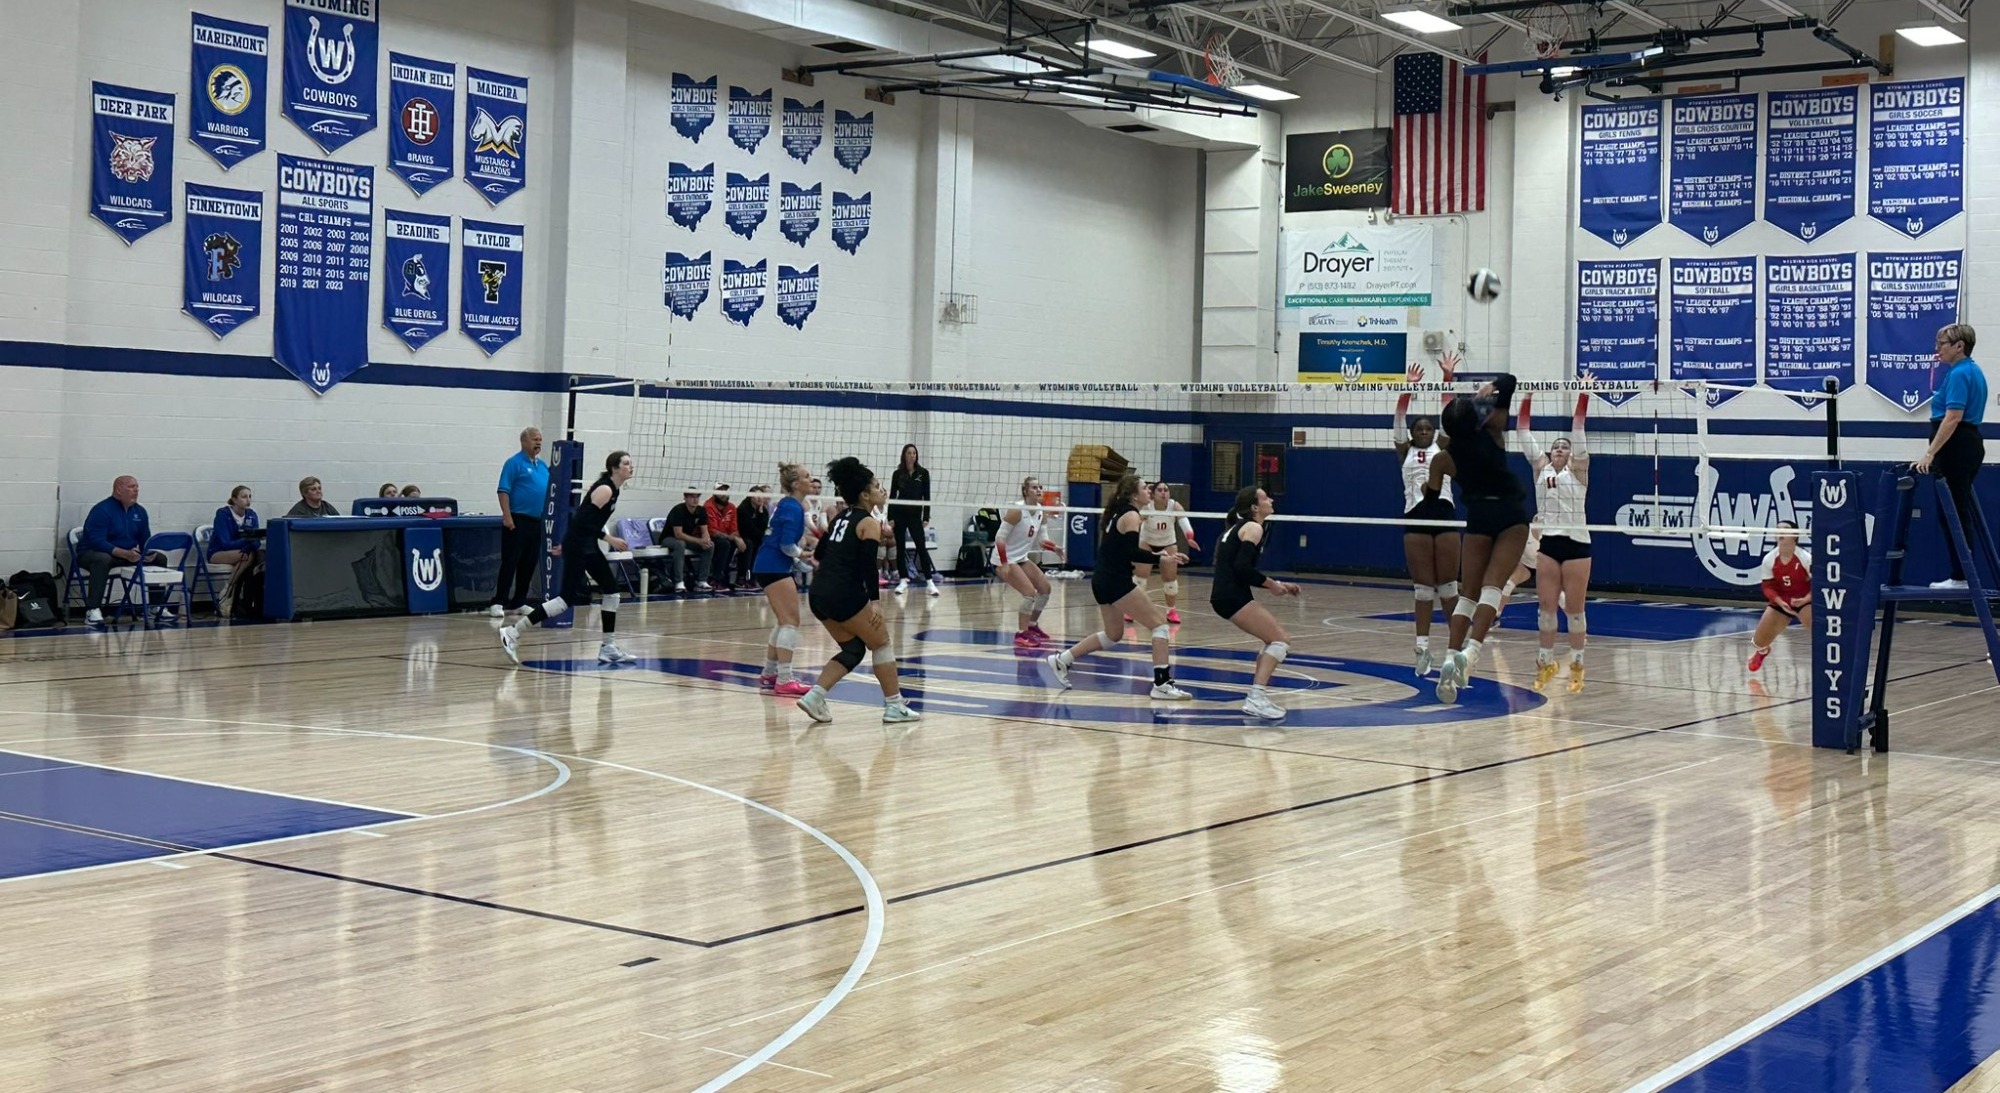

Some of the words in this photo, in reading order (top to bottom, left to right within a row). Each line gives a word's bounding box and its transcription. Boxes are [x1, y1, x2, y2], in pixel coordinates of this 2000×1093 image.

[296, 0, 369, 16] OMING
[196, 28, 264, 52] MARIEMONT
[318, 37, 344, 70] W
[393, 66, 425, 83] INDIAN
[430, 74, 452, 87] HILL
[303, 87, 357, 107] COWBOYS
[477, 82, 517, 99] MADEIRA
[672, 88, 718, 103] COWBOYS
[1874, 87, 1960, 109] COWBOYS
[100, 98, 131, 115] DEER
[137, 104, 167, 120] PARK
[729, 101, 772, 115] COWBOYS
[1675, 103, 1754, 123] COWBOYS
[1771, 96, 1854, 117] COWBOYS
[783, 112, 824, 127] COWBOYS
[1584, 109, 1658, 129] COWBOYS
[1889, 111, 1911, 119] GIRLS
[1913, 109, 1943, 118] SOCCER
[207, 122, 249, 136] WARRIORS
[1676, 126, 1696, 134] GIRLS
[1697, 125, 1719, 133] CROSS
[1720, 123, 1752, 132] COUNTRY
[1789, 118, 1833, 127] VOLLEYBALL
[1916, 122, 1946, 130] CHAMPS
[834, 123, 873, 138] COWBOYS
[1811, 130, 1839, 138] CHAMPS
[1619, 141, 1645, 149] CHAMPS
[1714, 136, 1740, 144] CHAMPS
[407, 153, 434, 164] BRAVES
[475, 155, 509, 167] MUSTANGS
[479, 165, 510, 176] AMAZONS
[1812, 169, 1841, 178] CHAMPS
[1918, 163, 1948, 172] CHAMPS
[281, 167, 370, 199] COWBOYS
[668, 177, 714, 192] COWBOYS
[1293, 183, 1383, 197] JakeSweeney
[1873, 181, 1883, 189] '21
[726, 186, 769, 201] COWBOYS
[110, 196, 152, 209] WILDCATS
[189, 198, 259, 217] FINNEYTOWN
[302, 196, 316, 206] ALL
[319, 199, 348, 210] SPORTS
[781, 195, 822, 210] COWBOYS
[832, 205, 871, 219] COWBOYS
[299, 213, 315, 222] CHL
[318, 216, 351, 227] CHAMPS
[1910, 222, 1919, 231] W
[280, 224, 298, 234] 2001
[303, 227, 322, 236] 2002
[327, 229, 345, 239] 2003
[350, 232, 369, 241] 2004
[397, 224, 439, 239] READING
[1707, 230, 1715, 239] W
[280, 237, 298, 248] 2005
[303, 240, 322, 250] 2006
[326, 242, 345, 252] 2007
[350, 245, 369, 254] 2008
[476, 234, 510, 247] TAYLOR
[280, 251, 298, 261] 2009
[303, 253, 321, 263] 2010
[326, 256, 344, 265] 2011
[350, 258, 369, 268] 2012
[1304, 252, 1375, 278] Drayer
[280, 265, 298, 274] 2013
[302, 267, 321, 276] 2014
[326, 269, 344, 279] 2015
[349, 271, 368, 281] 2016
[665, 265, 711, 282] COWBOYS
[1582, 268, 1656, 285] COWBOYS
[1674, 266, 1752, 284] COWBOYS
[1769, 263, 1852, 281] COWBOYS
[1871, 260, 1958, 279] COWBOYS
[280, 278, 296, 288] 2019
[302, 280, 318, 288] 2021
[326, 281, 343, 290] 2023
[723, 272, 767, 288] COWBOYS
[777, 277, 819, 294] COWBOYS
[1904, 282, 1946, 290] SWIMMING
[1695, 286, 1730, 294] SOFTBALL
[1775, 284, 1797, 292] GIRLS
[1799, 284, 1844, 292] BASKETBALL
[203, 293, 242, 304] WILDCATS
[1810, 296, 1838, 304] CHAMPS
[1913, 295, 1943, 303] CHAMPS
[395, 308, 412, 318] BLUE
[414, 310, 437, 319] DEVILS
[464, 313, 490, 323] YELLOW
[491, 315, 519, 325] JACKETS
[1345, 365, 1357, 374] W
[675, 380, 708, 388] WYOMING
[710, 380, 755, 388] VOLLEYBALL
[826, 382, 873, 390] VOLLEYBALL
[909, 383, 946, 391] WYOMING
[949, 384, 1000, 392] VOLLEYBALL
[1039, 383, 1080, 391] WYOMING
[1082, 383, 1138, 391] VOLLEYBALL
[1180, 384, 1224, 392] WYOMING
[1227, 384, 1289, 392] VOLLEYBALL
[1334, 383, 1383, 392] WYOMING
[1386, 382, 1454, 392] VOLLEYBALL
[1516, 382, 1559, 391] YOMING
[1563, 380, 1639, 391] VOLLEYBALL
[1417, 451, 1426, 463] 9
[1546, 477, 1556, 488] 11
[1825, 485, 1839, 501] W
[400, 505, 417, 515] POSS
[829, 519, 849, 542] 13
[1028, 525, 1034, 537] 6
[1156, 522, 1167, 530] 10
[1718, 493, 1772, 556] W
[419, 558, 435, 581] W
[1783, 576, 1791, 586] 5
[1822, 535, 1846, 718] COWBOYS
